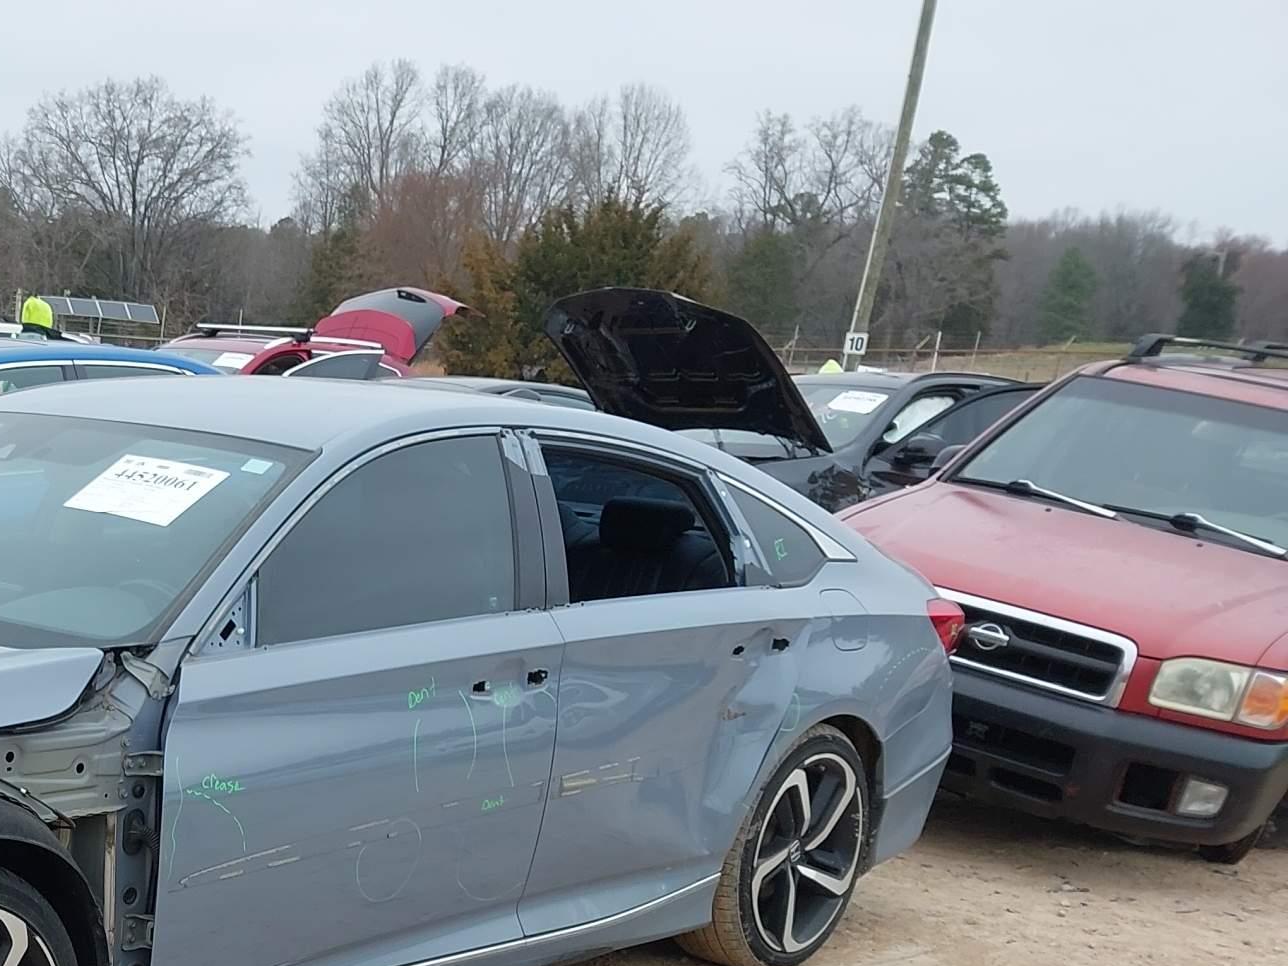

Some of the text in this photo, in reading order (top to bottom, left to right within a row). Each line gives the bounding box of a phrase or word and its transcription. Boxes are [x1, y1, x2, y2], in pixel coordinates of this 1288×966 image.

[848, 336, 865, 352] 10
[114, 468, 199, 492] 44520061
[407, 676, 436, 709] Dent
